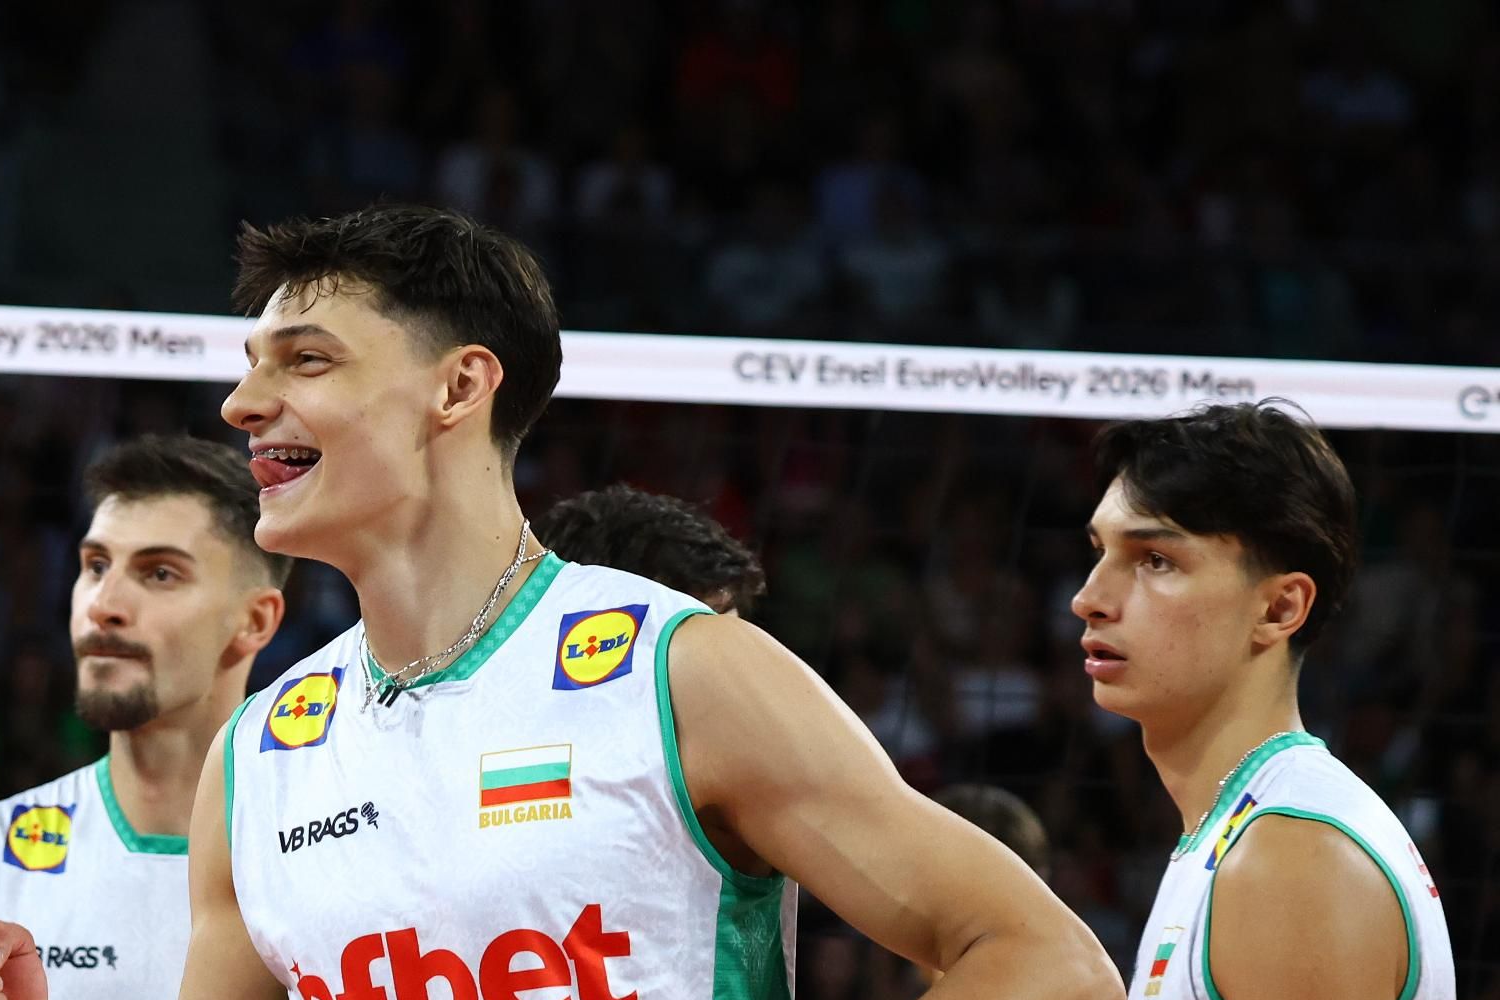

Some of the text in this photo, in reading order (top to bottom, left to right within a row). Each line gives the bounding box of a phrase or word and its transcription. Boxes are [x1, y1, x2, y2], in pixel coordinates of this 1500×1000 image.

[36, 320, 118, 350] 2026
[128, 325, 205, 354] Men
[733, 351, 1255, 401] CEV Enel EuroVolley 2026 Men
[278, 807, 359, 854] VB RAGS
[479, 803, 573, 829] BULGARIA
[47, 946, 99, 968] RAGS
